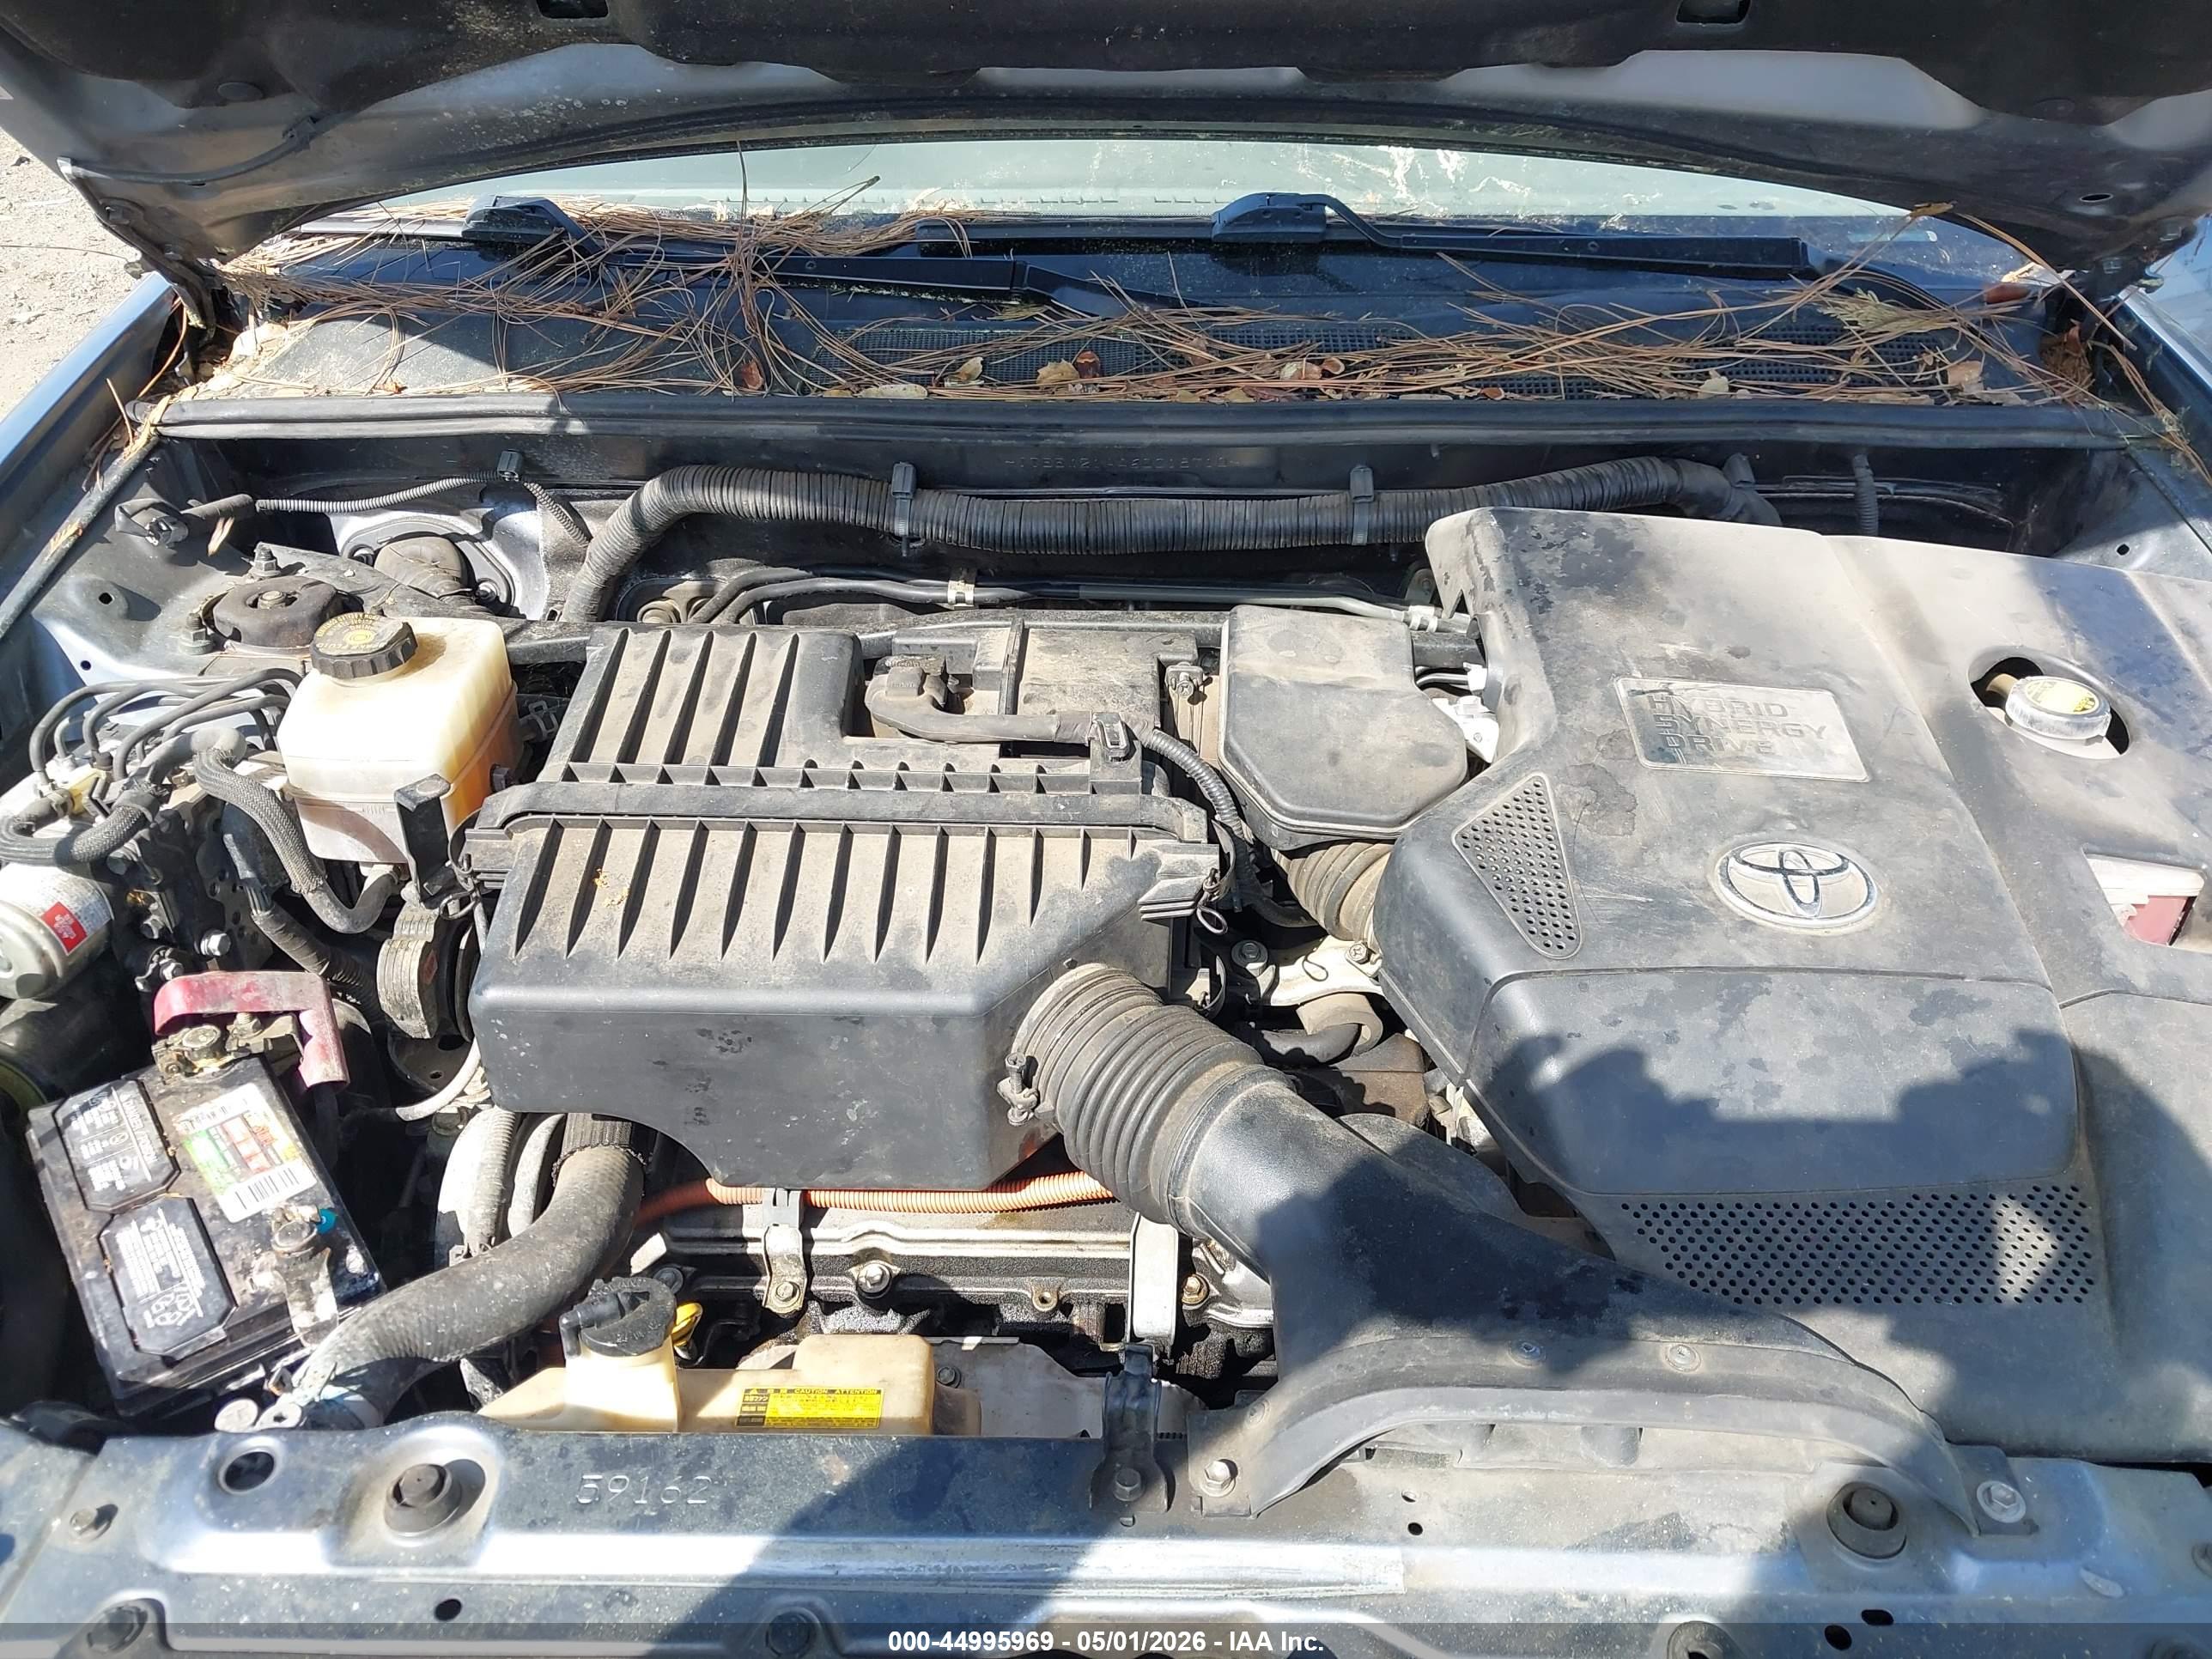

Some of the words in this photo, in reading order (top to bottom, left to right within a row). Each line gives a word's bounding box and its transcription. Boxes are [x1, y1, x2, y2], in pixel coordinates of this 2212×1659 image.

[1647, 693, 1790, 719] HYBRID
[1652, 714, 1827, 740] SYNERGY
[1658, 732, 1775, 756] DRIVE
[574, 1474, 712, 1505] 59162
